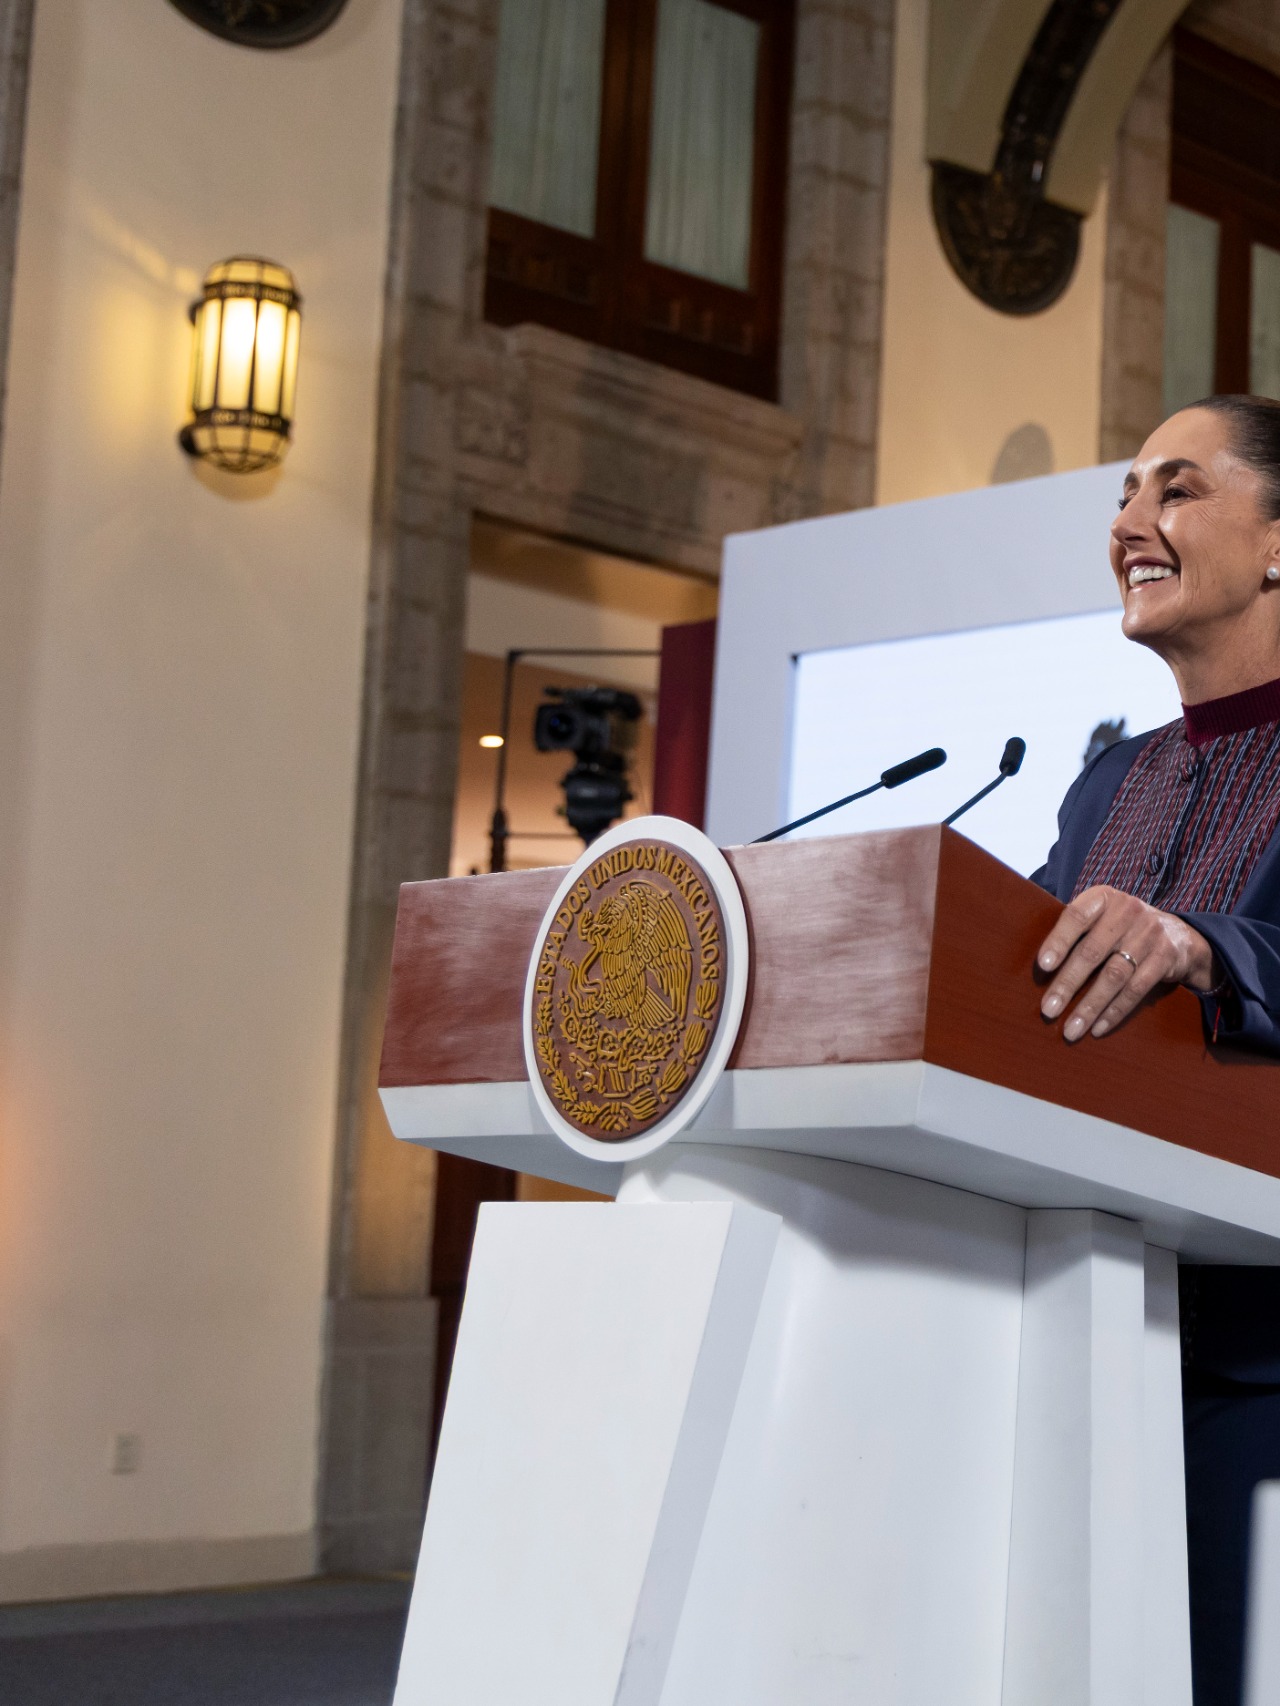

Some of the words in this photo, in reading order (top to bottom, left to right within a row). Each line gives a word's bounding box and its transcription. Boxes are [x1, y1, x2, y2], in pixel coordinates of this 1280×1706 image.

[536, 880, 591, 994] ESTADOS
[587, 846, 657, 890] UNIDOS
[656, 846, 720, 981] MEXICANOS
